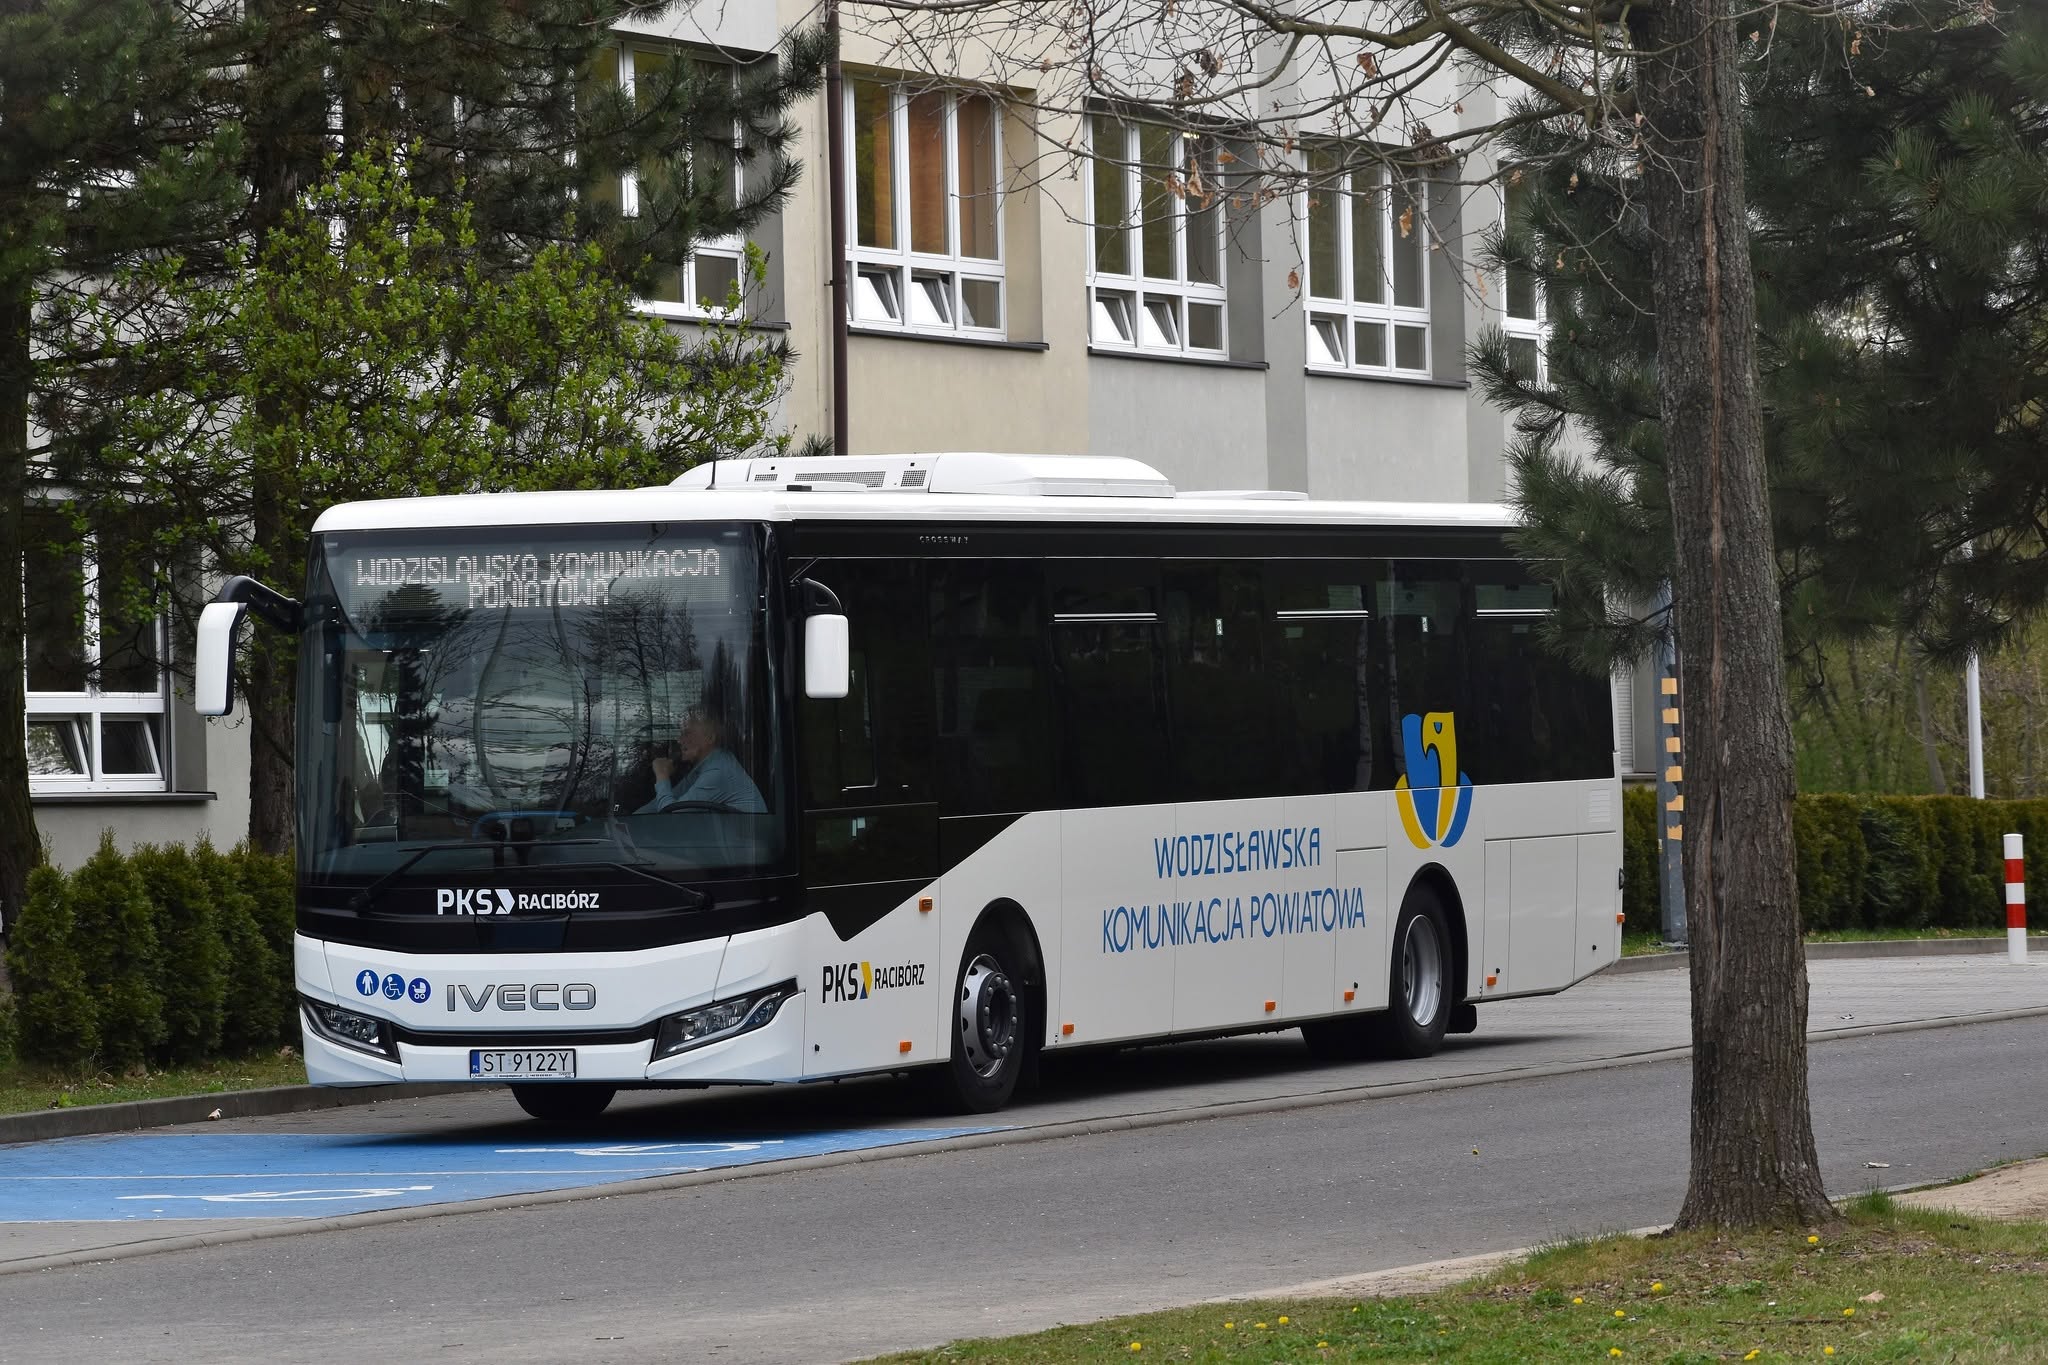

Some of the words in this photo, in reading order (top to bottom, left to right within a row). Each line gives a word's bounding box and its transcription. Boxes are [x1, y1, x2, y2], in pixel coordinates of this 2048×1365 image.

[356, 554, 538, 586] WODZISLAWSKA
[550, 549, 720, 581] KOMUNIKACJA
[468, 578, 609, 609] POWIATOWA
[1154, 827, 1320, 879] WODZISŁAWSKA
[437, 888, 493, 915] PKS
[518, 890, 600, 910] RACIBÓRZ
[1103, 897, 1245, 954] KOMUNIKACJA
[1250, 887, 1366, 939] POWIATOWA
[446, 983, 597, 1013] IVECO
[822, 962, 858, 1004] PKS
[874, 960, 925, 990] RACIBÓRZ
[483, 1053, 506, 1072] ST
[513, 1052, 569, 1072] 9122Y
